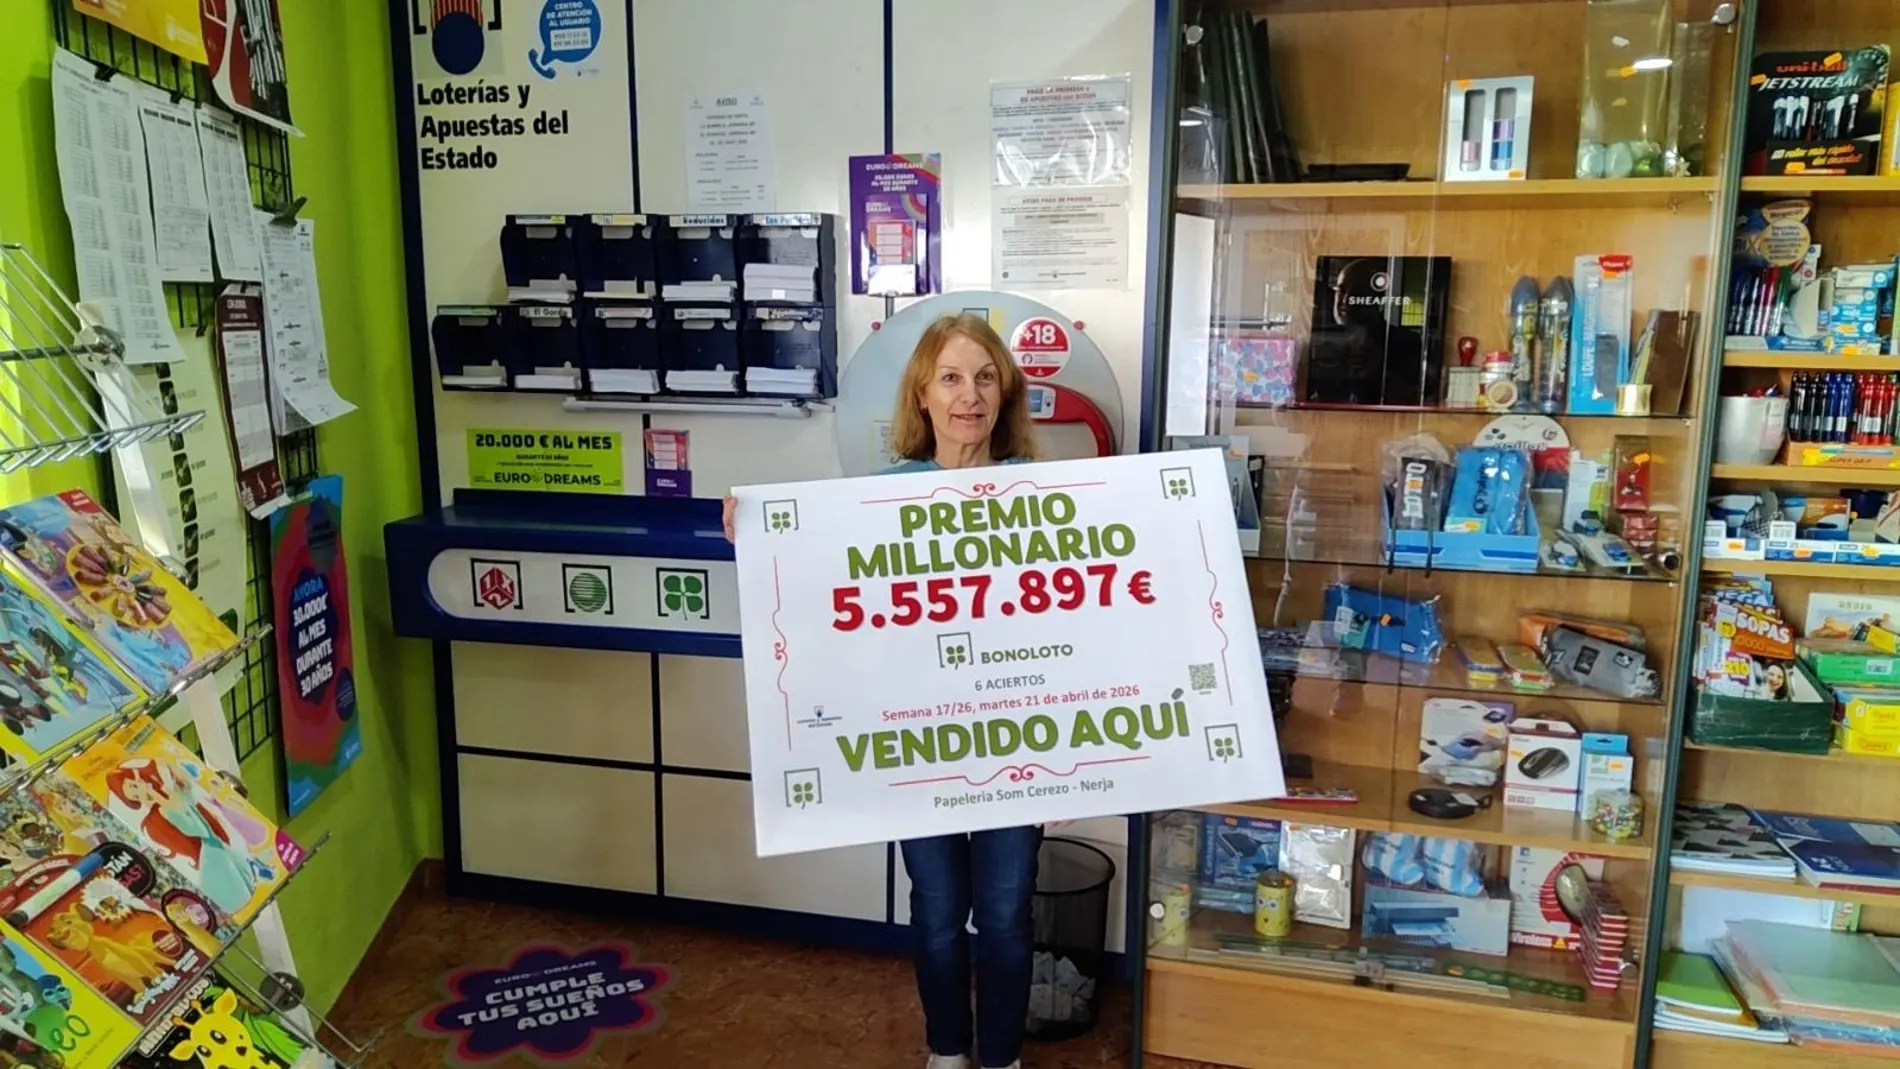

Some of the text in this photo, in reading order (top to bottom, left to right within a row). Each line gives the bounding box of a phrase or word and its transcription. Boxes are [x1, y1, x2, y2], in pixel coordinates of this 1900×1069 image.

[546, 11, 556, 19] DE
[554, 1, 583, 10] CENTRO
[560, 17, 591, 26] USUARIO
[417, 79, 531, 108] Loterías y
[1759, 76, 1859, 91] JETSTREAM
[421, 110, 568, 143] Apuestas del
[421, 145, 497, 170] Estado
[683, 215, 725, 224] Reducidos
[1348, 296, 1411, 306] SHEAFFER
[1020, 324, 1057, 345] +18
[475, 433, 612, 450] 20.000 € AL MES
[494, 472, 531, 484] EURO
[544, 472, 601, 485] DREAMS
[900, 492, 1076, 538] PREMIO
[848, 523, 1136, 580] MILLONARIO
[294, 576, 324, 601] AHORA
[832, 563, 1157, 632] 5.557.897 €
[308, 618, 327, 643] MES
[1736, 611, 1791, 644] SOPAS
[296, 637, 333, 676] DURANTE
[980, 644, 1074, 664] BONOLOTO
[311, 661, 333, 690] AÑOS
[974, 674, 1045, 691] 6 ACIERTOS
[882, 684, 1140, 722] Semana 17/26, martes 21 de abril de 2026
[836, 688, 1189, 772] VENDIDO AQUÍ
[934, 791, 993, 809] Papeleria
[996, 788, 1024, 802] Som
[1027, 783, 1070, 797] Cerezo
[1080, 778, 1114, 792] Nerja
[494, 959, 597, 984] EURO DREAMS
[485, 972, 606, 1005] CUMPLE
[457, 978, 645, 1026] TUS SUEÑOS
[517, 1000, 599, 1030] AQUÍ
